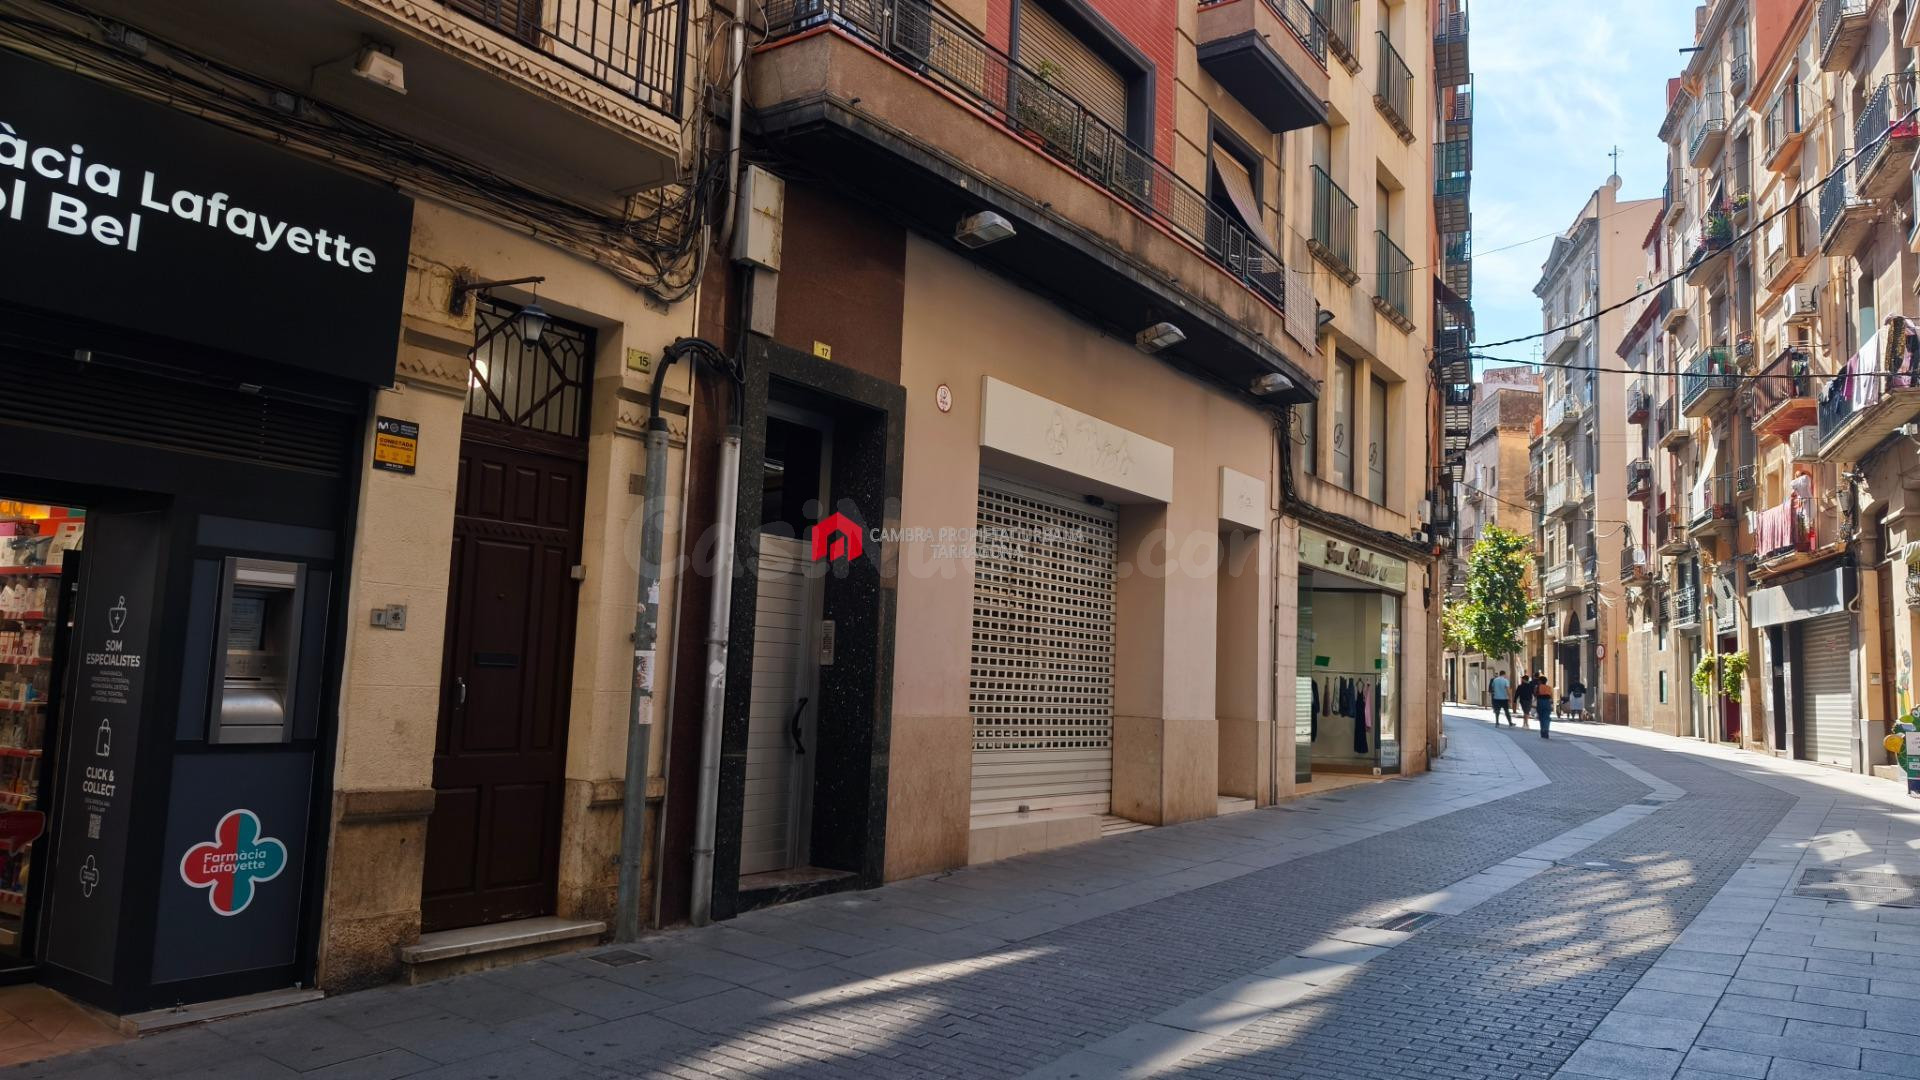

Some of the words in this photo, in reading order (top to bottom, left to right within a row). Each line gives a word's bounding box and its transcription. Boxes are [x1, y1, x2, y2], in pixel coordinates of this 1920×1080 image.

[0, 179, 26, 220] l
[48, 192, 141, 252] Bel
[141, 170, 377, 273] Lafayette
[822, 347, 830, 357] 17
[638, 355, 649, 367] 15
[105, 639, 123, 652] SOM
[86, 653, 141, 668] ESPECIALISTES
[86, 766, 107, 781] CLICK
[108, 769, 115, 782] &
[82, 781, 116, 797] COLLECT
[204, 848, 267, 864] Farmàcia
[203, 860, 266, 874] Lafayette
